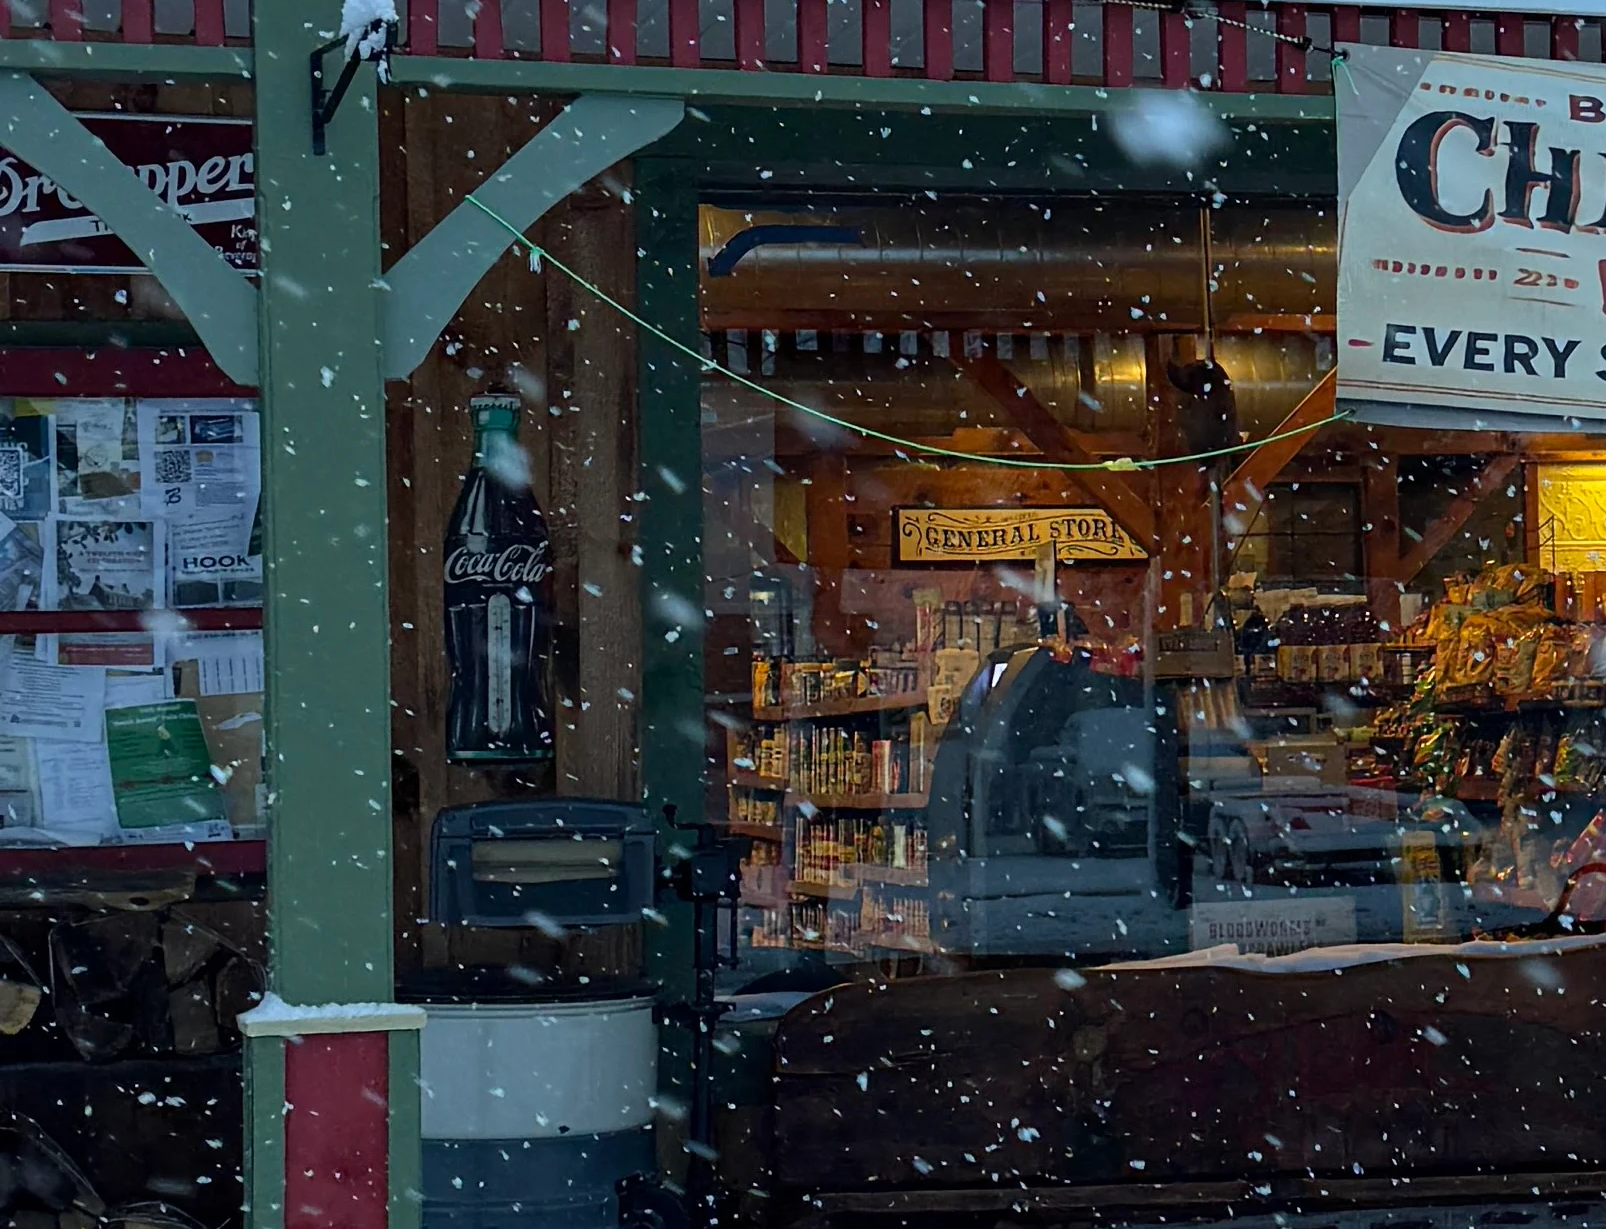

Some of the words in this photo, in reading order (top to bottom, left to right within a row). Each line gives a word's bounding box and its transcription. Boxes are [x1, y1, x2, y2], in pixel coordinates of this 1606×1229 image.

[1381, 323, 1583, 380] EVERY
[924, 519, 1042, 549] GENERAL
[444, 544, 549, 584] Coca-Cola
